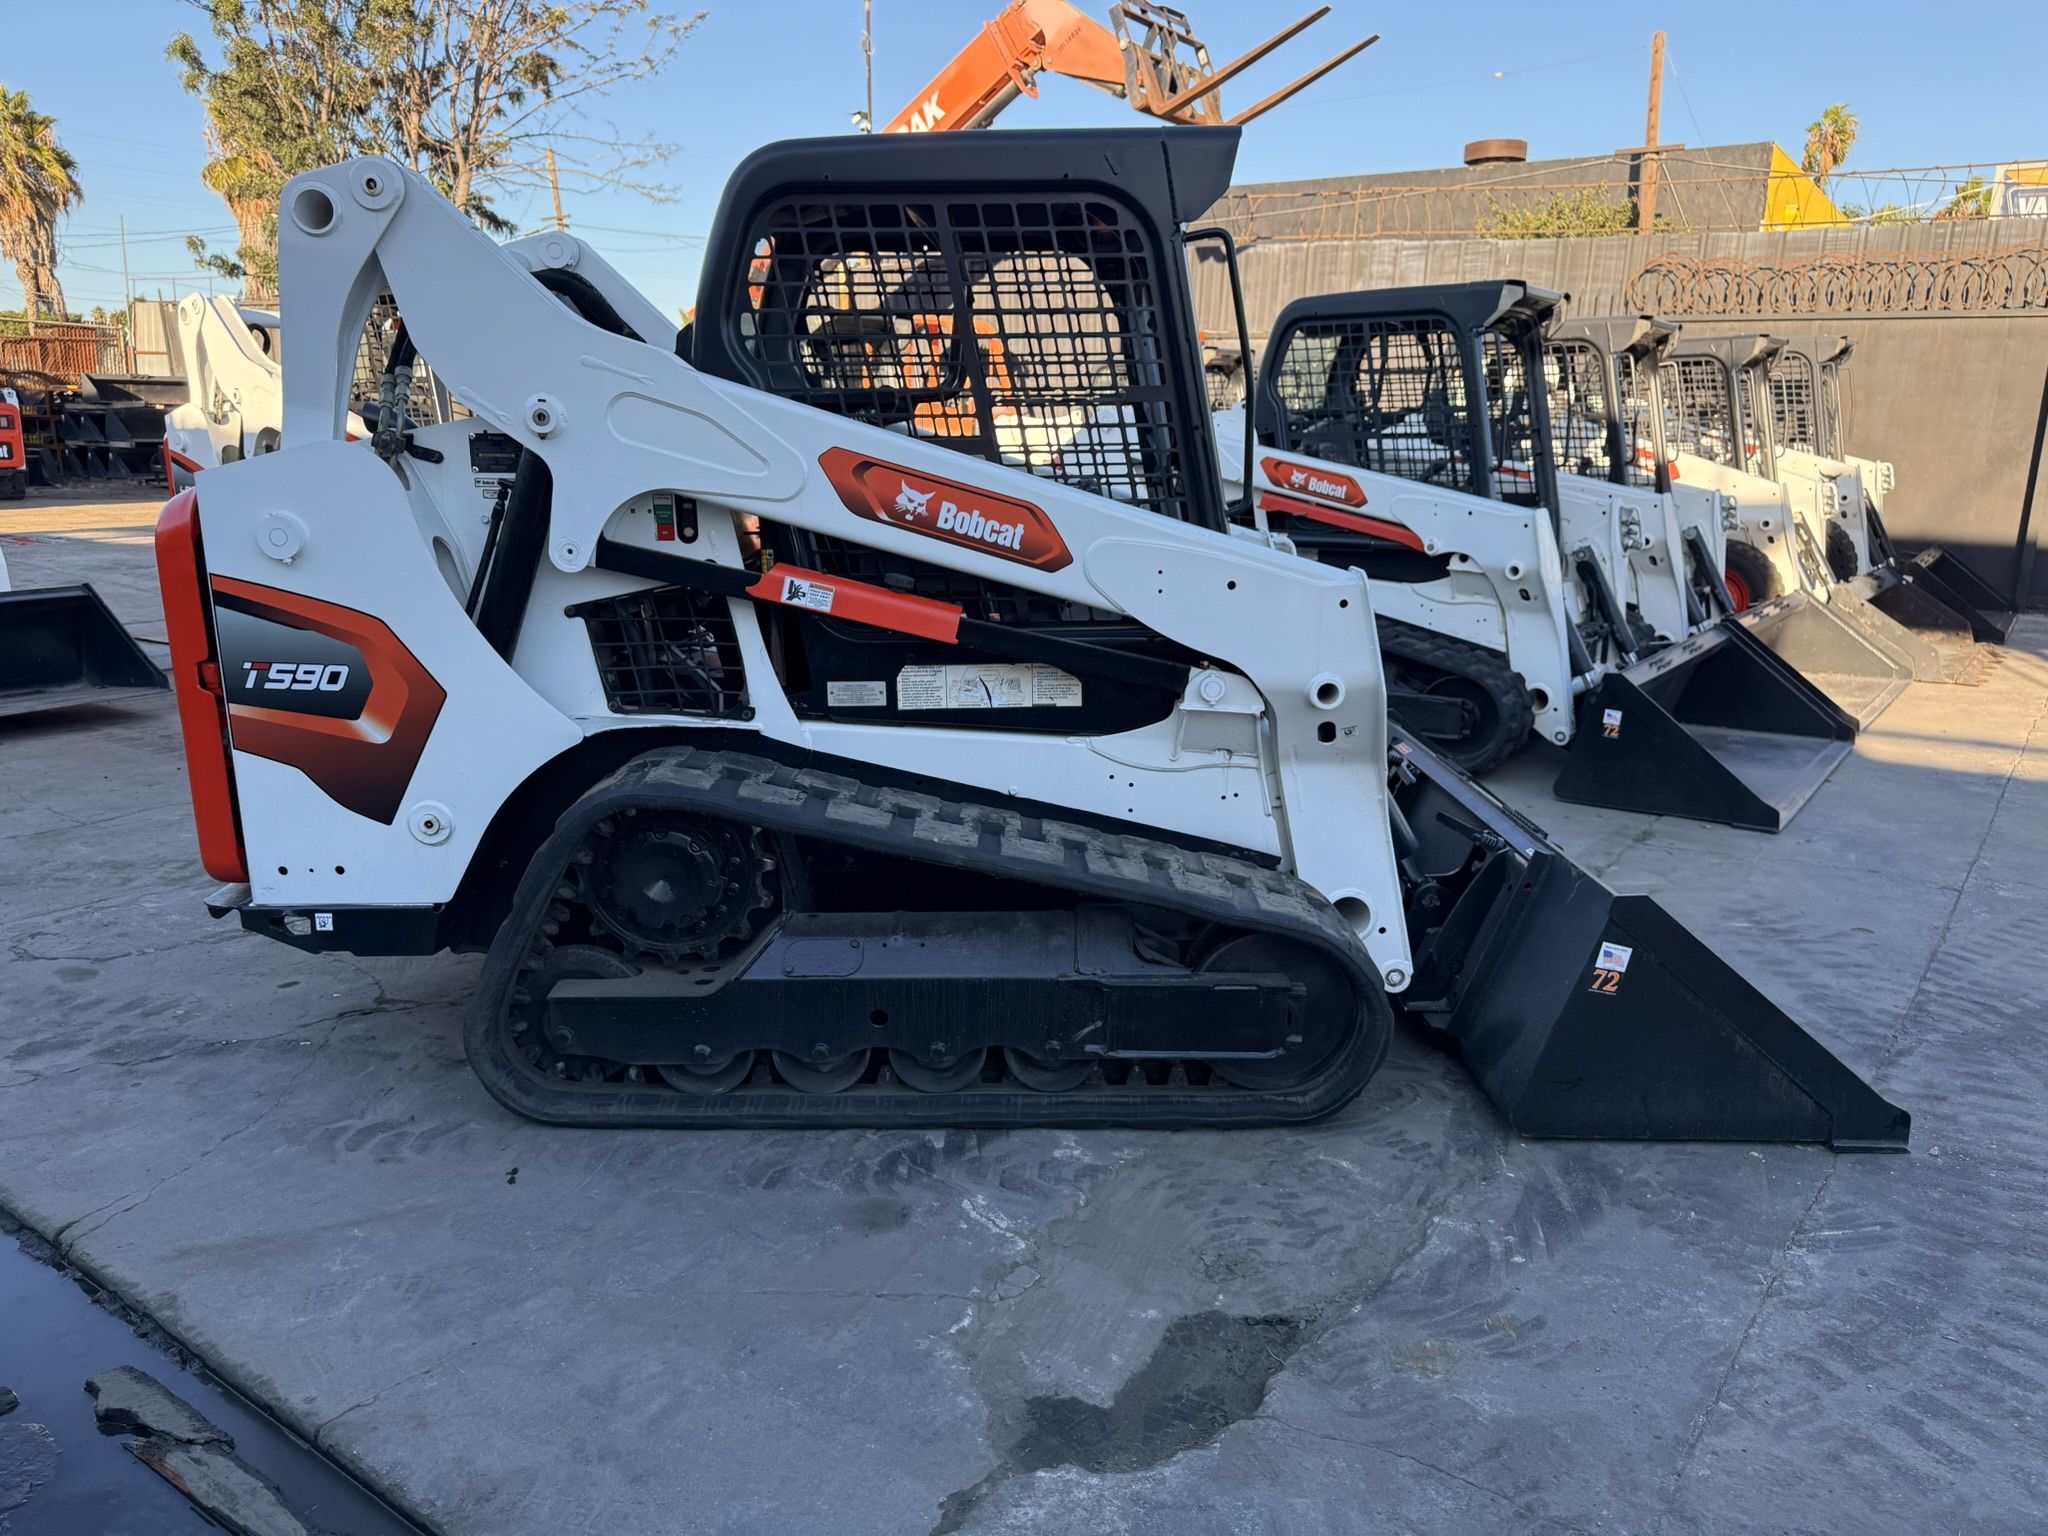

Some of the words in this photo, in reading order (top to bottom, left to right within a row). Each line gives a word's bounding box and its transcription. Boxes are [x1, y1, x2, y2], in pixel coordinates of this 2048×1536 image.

[1308, 476, 1347, 499] Bobcat
[936, 501, 1024, 551] Bobcat
[242, 661, 350, 692] T590
[1603, 724, 1619, 737] 72
[1592, 968, 1621, 992] 72
